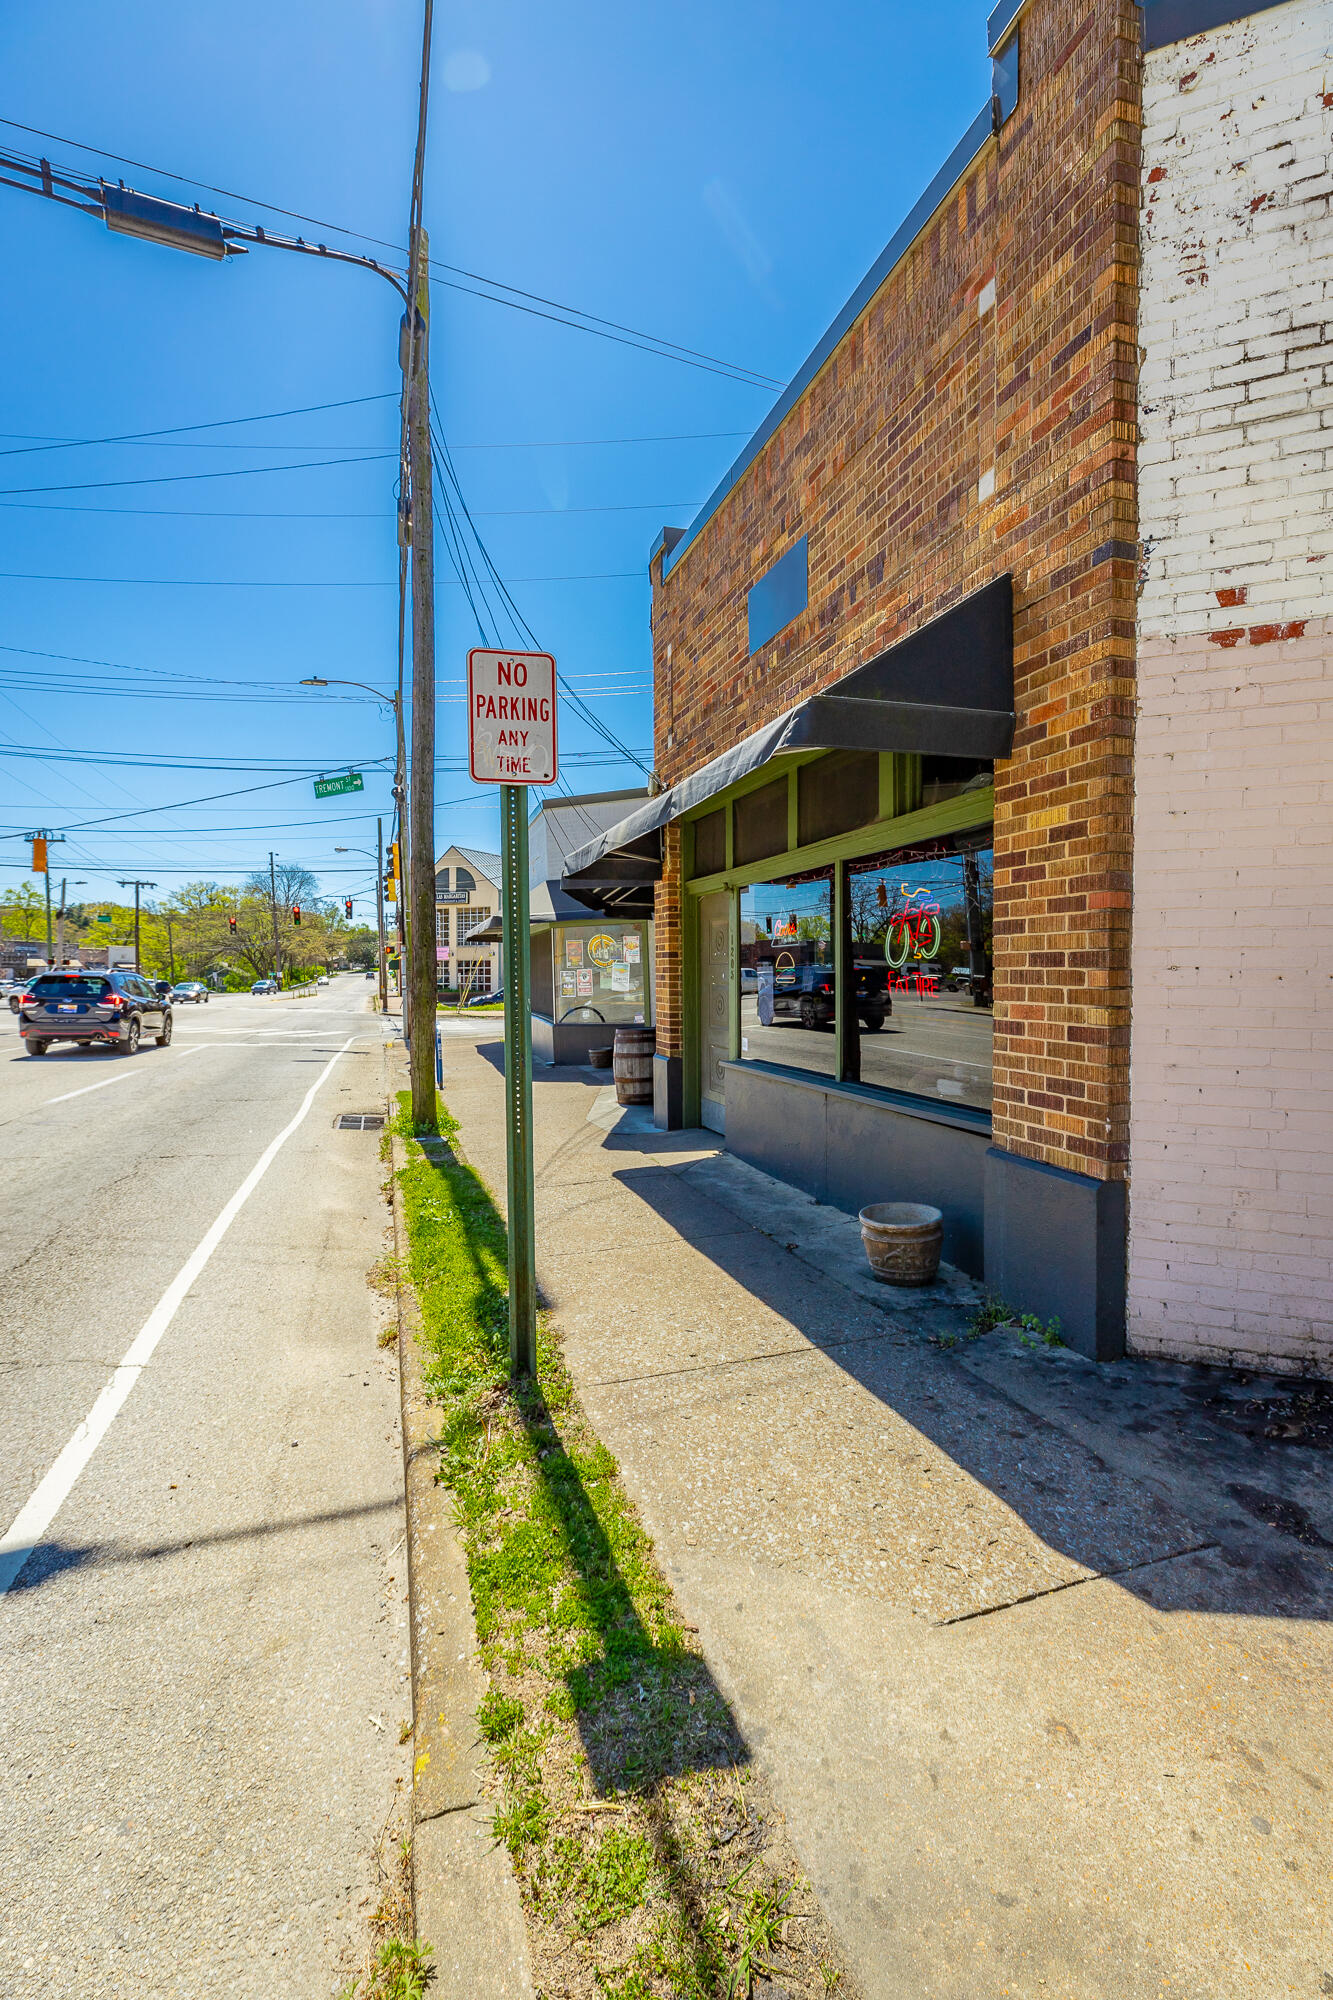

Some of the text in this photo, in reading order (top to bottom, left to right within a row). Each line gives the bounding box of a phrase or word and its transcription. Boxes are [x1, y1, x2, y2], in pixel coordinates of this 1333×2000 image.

[497, 661, 528, 688] NO
[476, 694, 550, 722] PARKING
[498, 729, 529, 747] ANY
[496, 755, 532, 773] TIME
[315, 780, 344, 794] TREMONT
[888, 971, 940, 998] FAT TIRE
